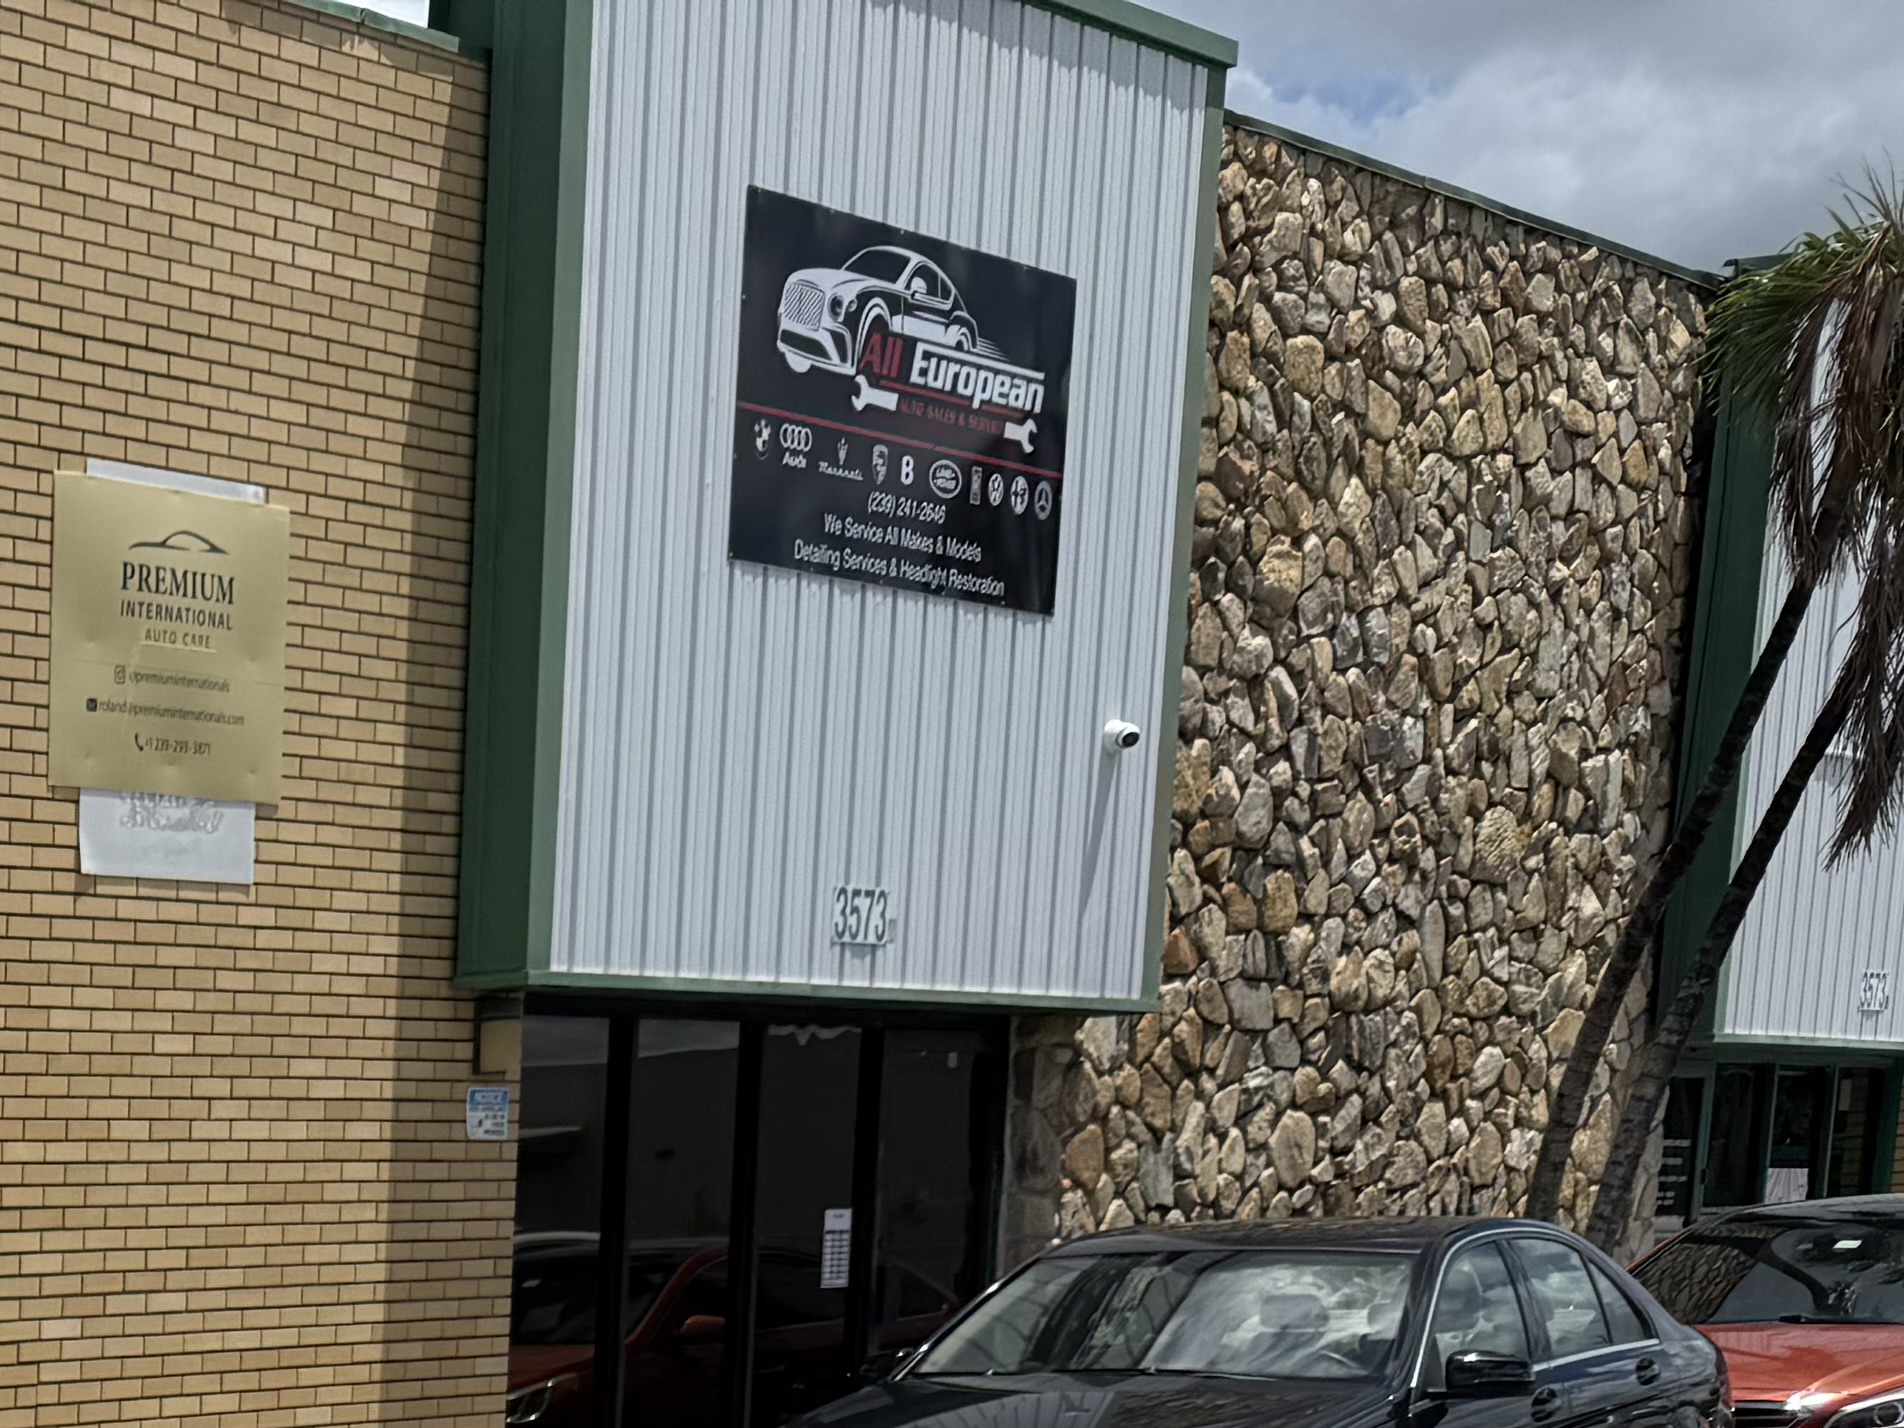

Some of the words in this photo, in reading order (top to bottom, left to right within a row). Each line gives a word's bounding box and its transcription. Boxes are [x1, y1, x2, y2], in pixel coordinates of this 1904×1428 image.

[860, 333, 903, 377] All
[910, 343, 1045, 413] European
[824, 512, 842, 535] We
[844, 516, 884, 543] Service
[884, 526, 899, 545] All
[900, 527, 934, 553] Makes
[936, 535, 943, 555] &
[945, 536, 982, 563] Models
[120, 561, 235, 605] PREMIUM
[794, 539, 841, 571] Detailing
[842, 548, 887, 576] Services
[889, 557, 897, 577] &
[899, 559, 947, 589] Headlight
[948, 568, 1005, 597] Restoration
[120, 599, 233, 631] INTERNATIONAL
[144, 627, 178, 645] AUTO
[833, 886, 889, 942] 3573
[1859, 971, 1887, 1010] 3573
